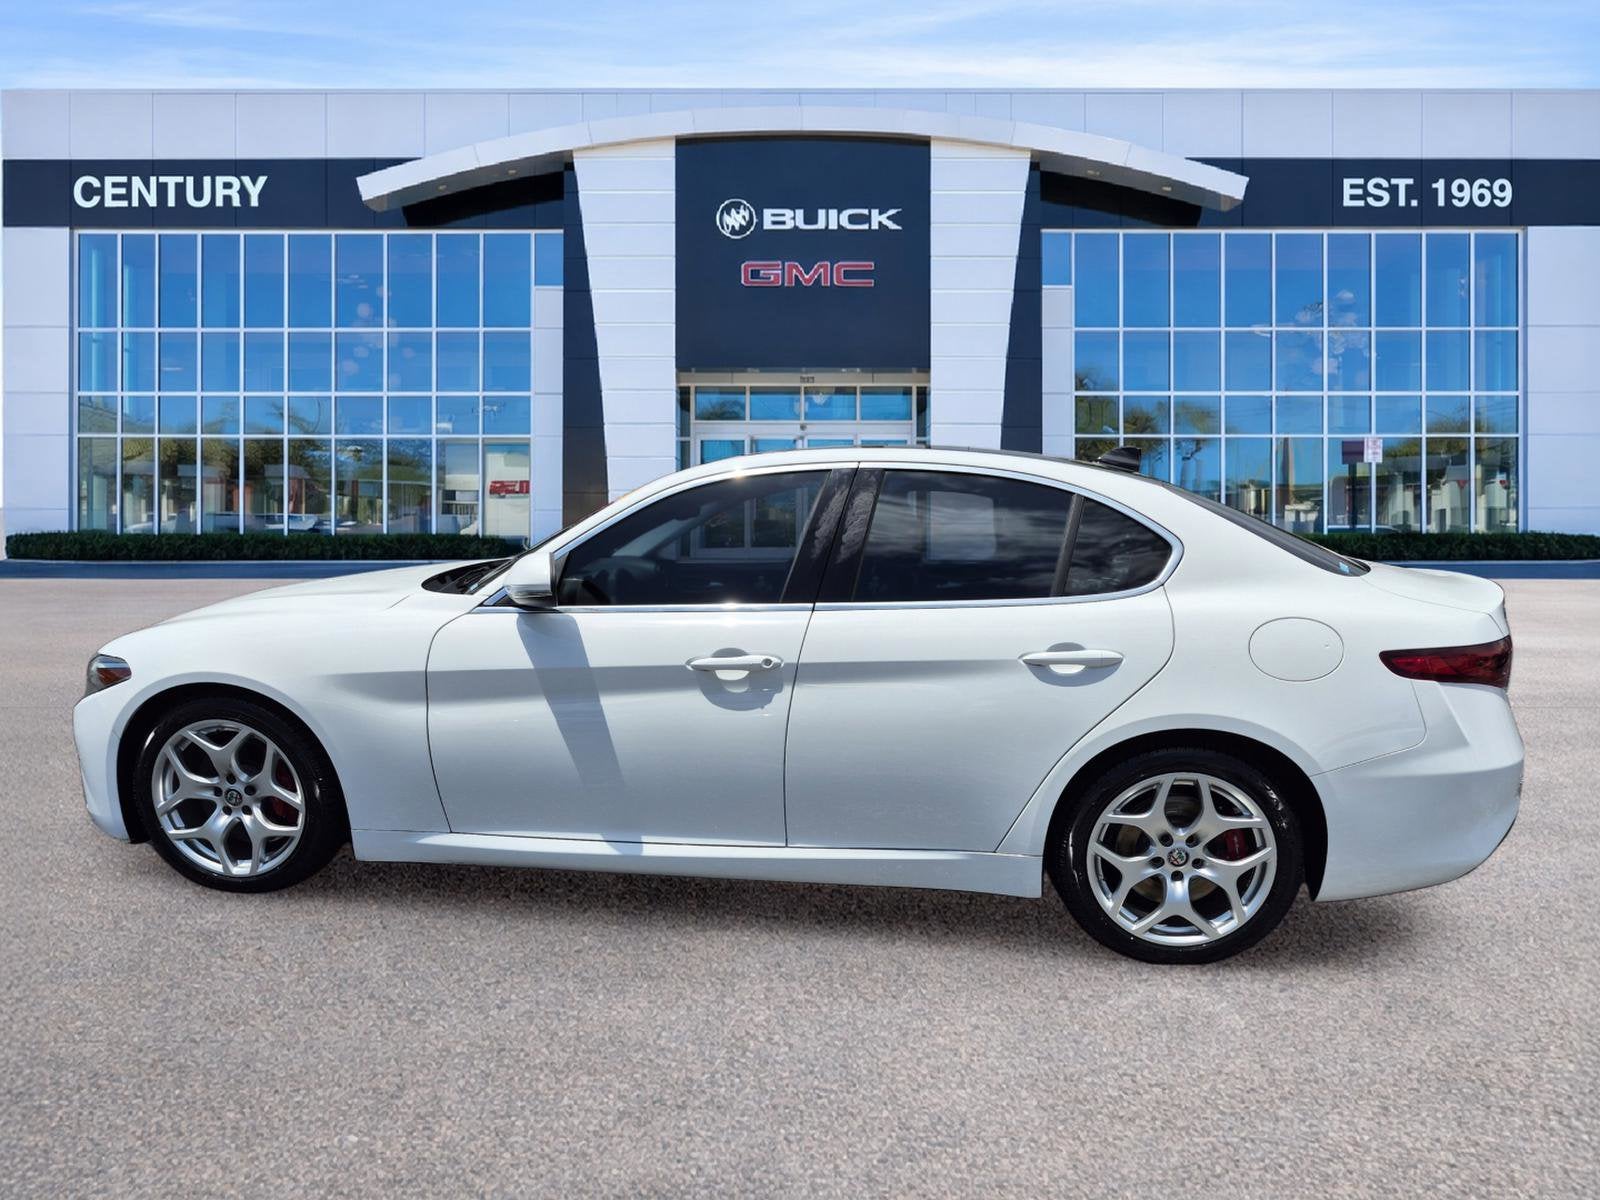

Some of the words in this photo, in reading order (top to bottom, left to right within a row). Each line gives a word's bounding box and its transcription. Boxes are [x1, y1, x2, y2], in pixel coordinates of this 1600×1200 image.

[73, 175, 268, 209] CENTURY
[1342, 177, 1418, 208] EST.
[1431, 178, 1513, 209] 1969
[762, 208, 903, 230] BUICK
[740, 260, 875, 287] GMC
